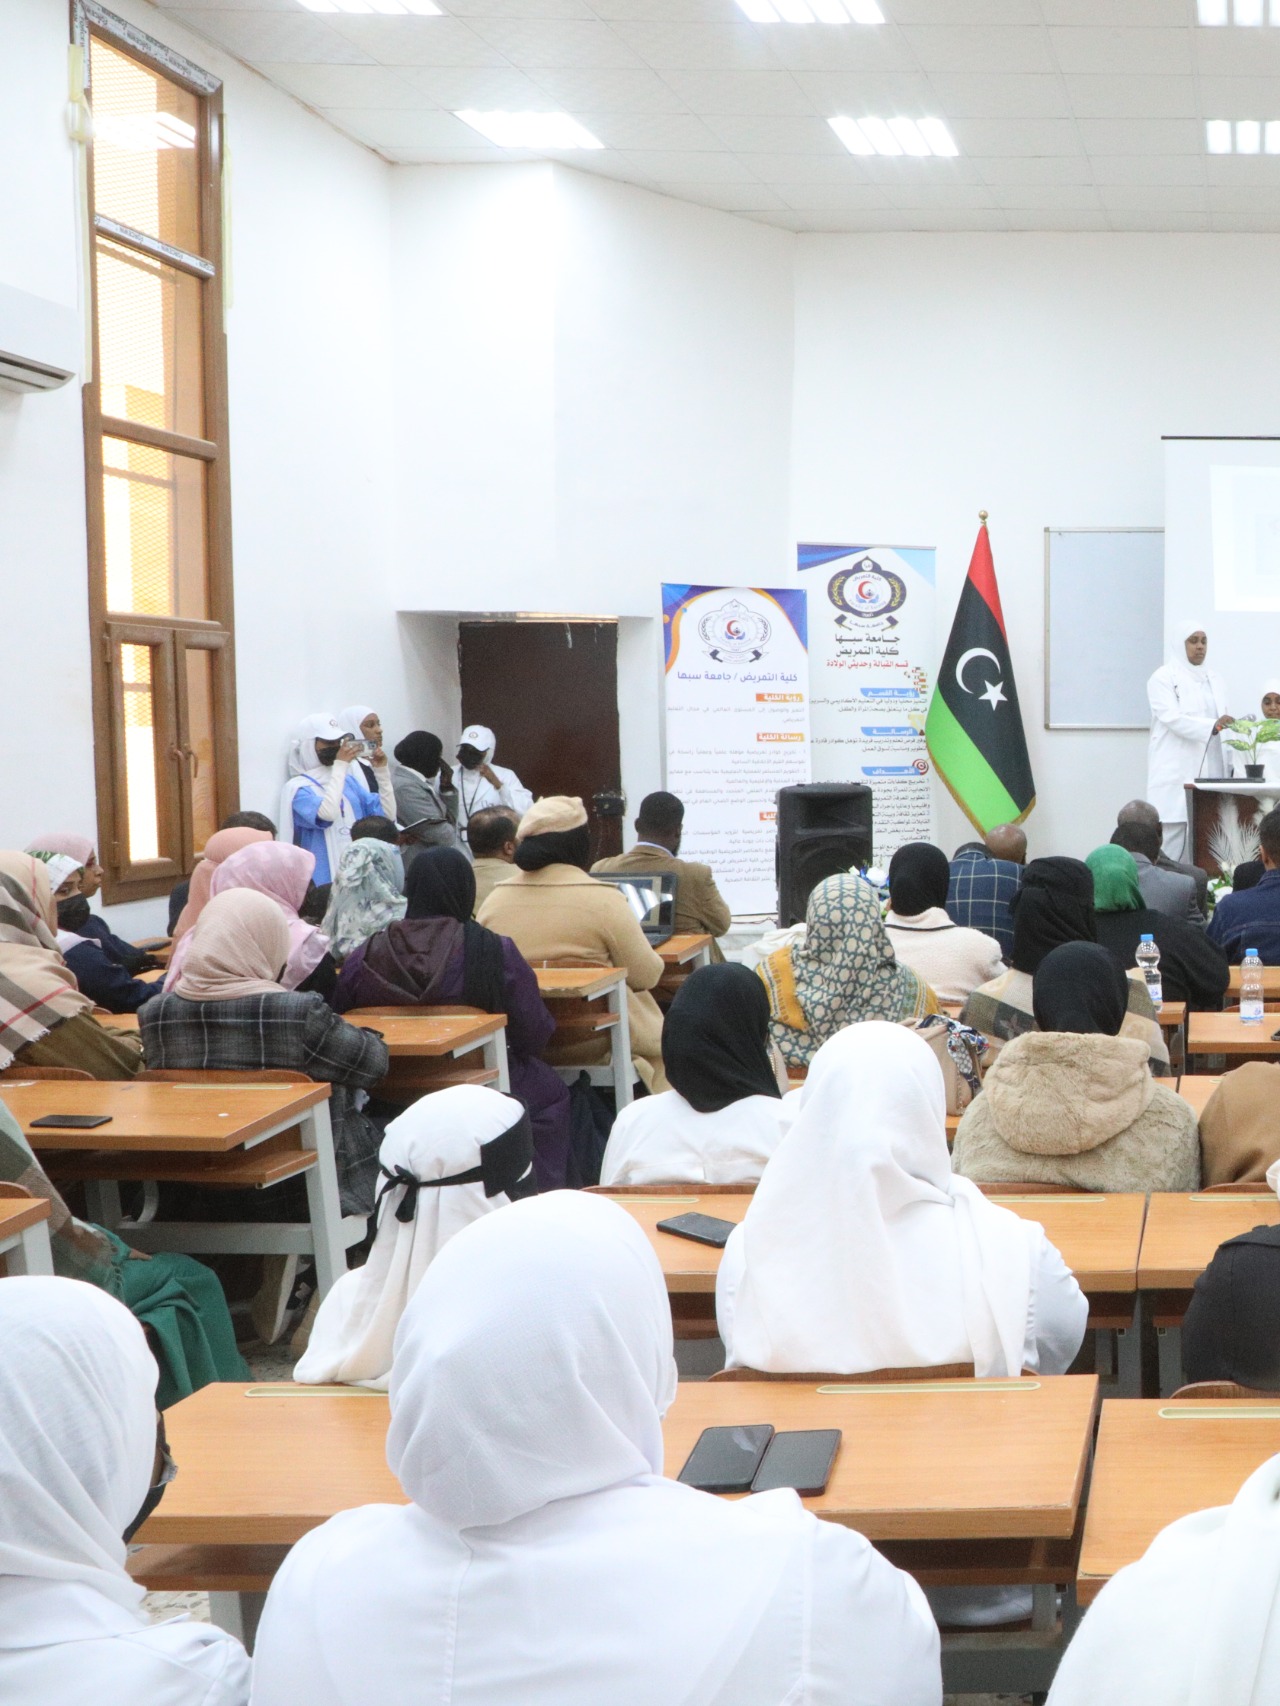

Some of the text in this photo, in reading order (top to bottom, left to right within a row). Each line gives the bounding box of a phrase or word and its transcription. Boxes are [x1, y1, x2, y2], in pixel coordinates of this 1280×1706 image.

[836, 645, 900, 658] كلية التمريض
[677, 671, 702, 682] سبها
[704, 671, 732, 683] جامعة
[740, 672, 778, 684] التمريض
[780, 673, 798, 684] كلية
